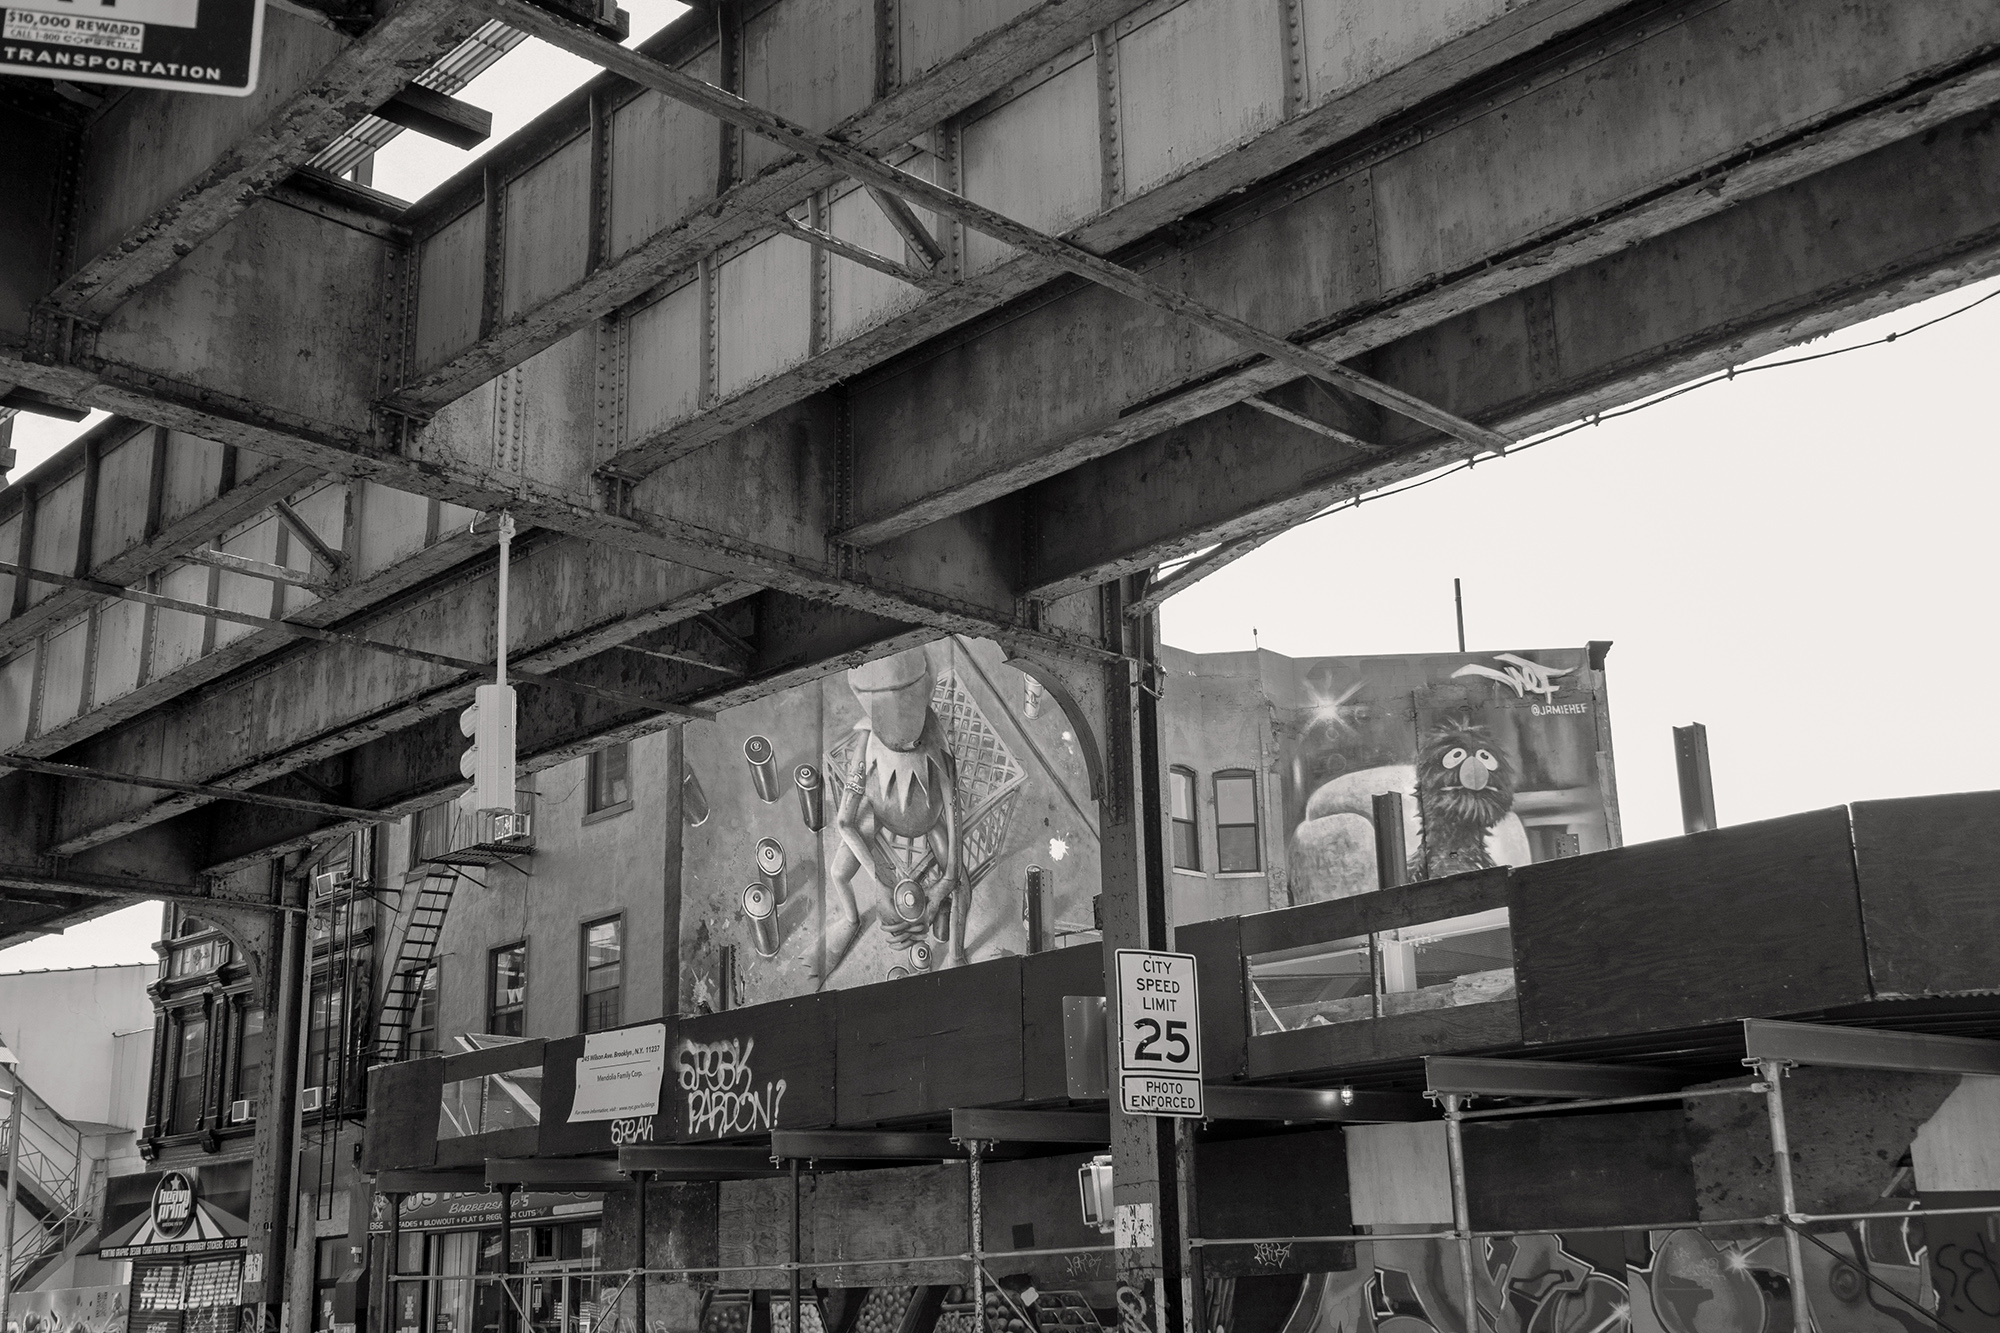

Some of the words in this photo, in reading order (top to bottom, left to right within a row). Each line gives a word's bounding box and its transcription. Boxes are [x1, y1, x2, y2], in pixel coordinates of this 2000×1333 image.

[8, 11, 71, 28] $10,000
[75, 19, 140, 36] REWARD
[10, 29, 31, 39] CALL
[4, 46, 221, 80] TRANSPORTATION
[1142, 960, 1173, 975] CITY
[1136, 978, 1181, 994] SPEED
[1142, 996, 1177, 1013] LIMIT
[1133, 1017, 1190, 1064] 25
[590, 1053, 604, 1061] Wilson
[645, 1045, 660, 1053] 11237
[617, 1070, 631, 1080] Family
[631, 1070, 643, 1078] Corp.
[1146, 1081, 1183, 1095] PHOTO
[1131, 1094, 1196, 1110] ENFORCED
[610, 1115, 653, 1144] SPEAK
[158, 1188, 191, 1208] heavy
[157, 1203, 188, 1223] print
[424, 1217, 455, 1226] BLOWOUT
[461, 1215, 478, 1223] FLAT
[518, 1209, 537, 1218] CUTS
[130, 1246, 141, 1256] DESIGN
[153, 1244, 169, 1254] PRINTING
[170, 1243, 184, 1253] CUSTOM
[206, 1240, 224, 1250] STICKERS
[225, 1238, 238, 1249] FLYERS
